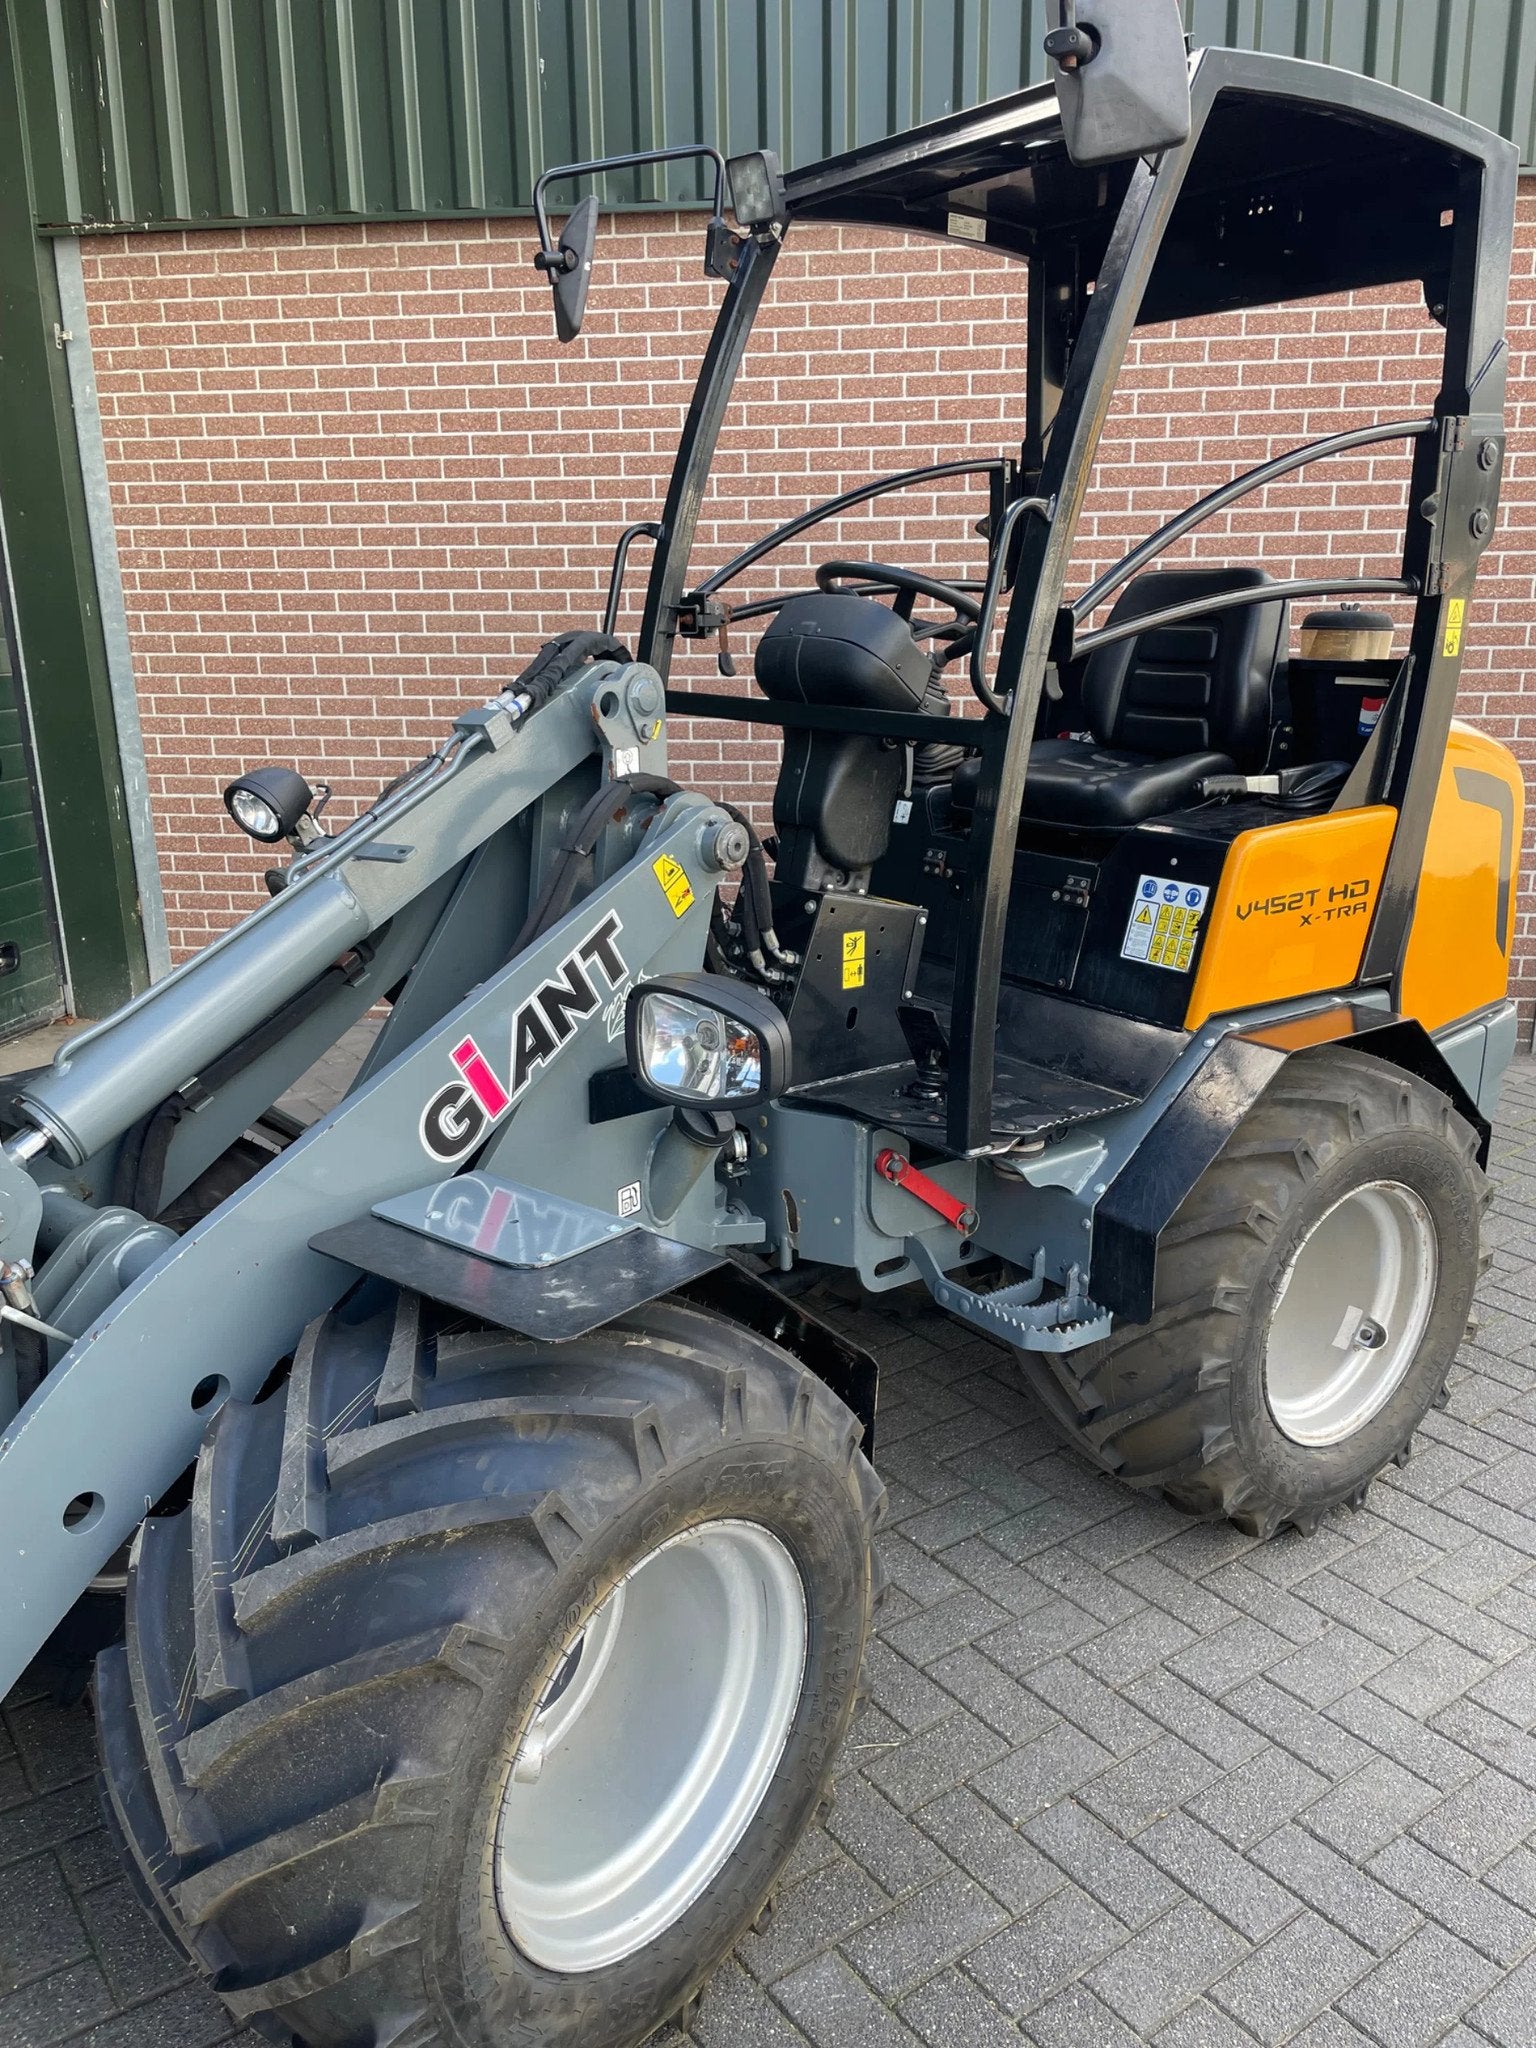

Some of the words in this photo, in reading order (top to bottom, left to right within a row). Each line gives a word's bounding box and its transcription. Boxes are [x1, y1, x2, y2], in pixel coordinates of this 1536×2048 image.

[1236, 888, 1321, 921] V452T
[1328, 879, 1370, 903] HD
[1299, 901, 1368, 928] X-TRA
